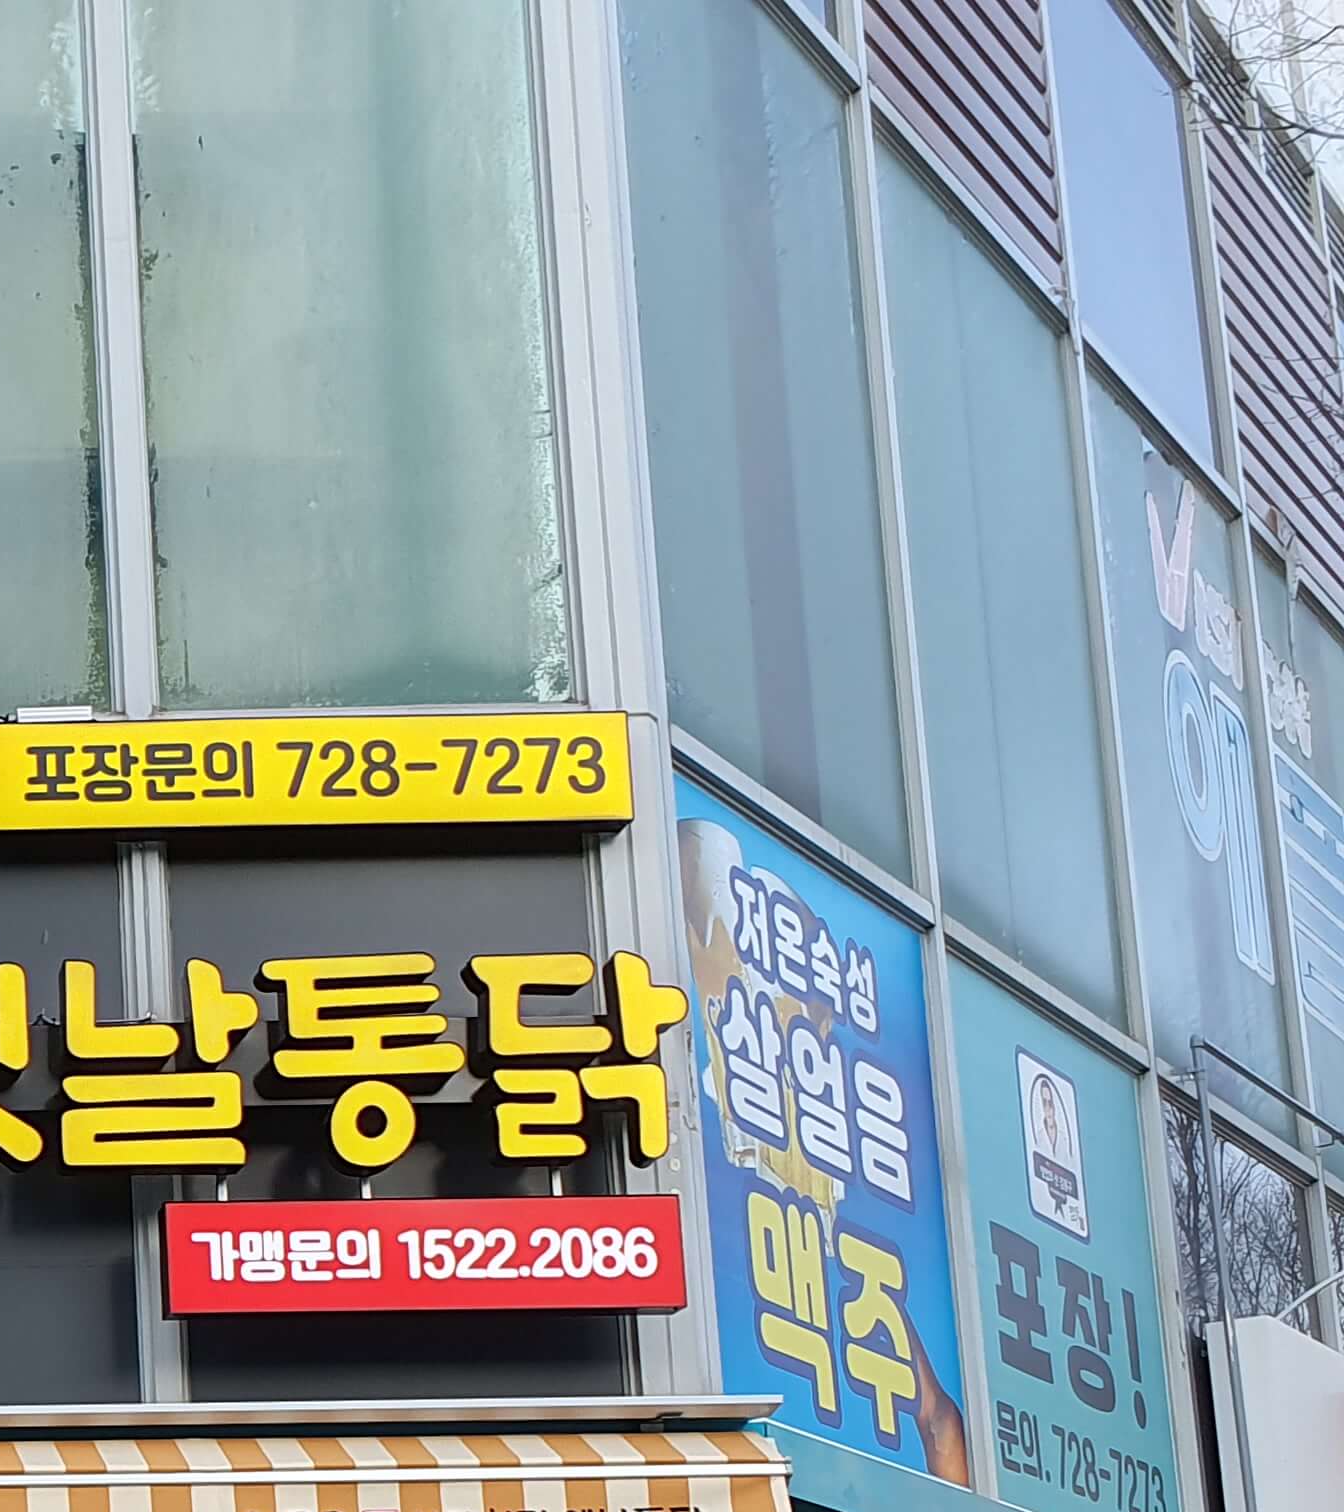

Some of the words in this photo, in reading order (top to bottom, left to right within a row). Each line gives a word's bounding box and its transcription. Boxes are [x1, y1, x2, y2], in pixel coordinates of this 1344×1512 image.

[23, 742, 255, 802] 포장문의
[276, 736, 607, 798] 728-7273
[732, 868, 876, 1034] 저온숙성
[723, 987, 912, 1202] 살얼음
[191, 1229, 381, 1282] 가맹문의
[398, 1226, 659, 1281] 1522.2086
[747, 1191, 917, 1435] 맥주
[990, 1221, 1147, 1430] 포장!
